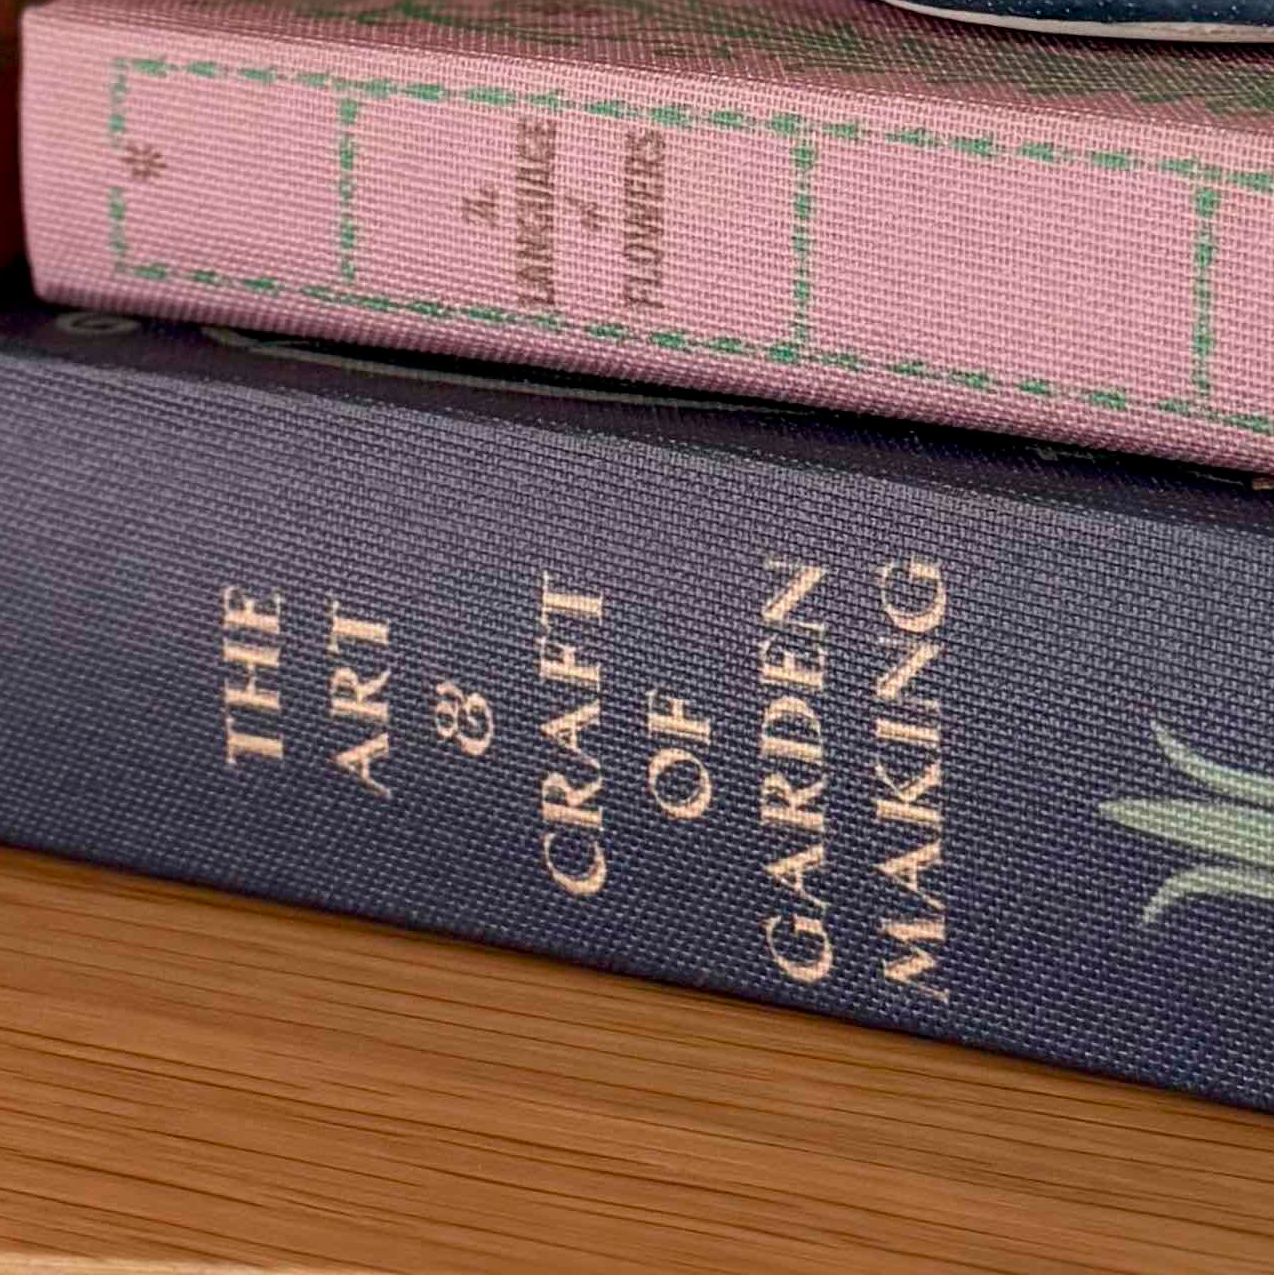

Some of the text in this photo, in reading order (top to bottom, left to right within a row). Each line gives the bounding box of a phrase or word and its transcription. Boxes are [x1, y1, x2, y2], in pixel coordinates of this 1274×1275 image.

[516, 117, 556, 306] LANGUAGE
[625, 128, 665, 310] FLOWERS
[221, 582, 284, 767] THE
[327, 597, 393, 801] ART
[432, 680, 496, 759] &
[537, 570, 609, 898] CRAFT
[647, 683, 713, 821] OF
[759, 554, 835, 985] GARDEN
[871, 554, 950, 1006] MAKING
